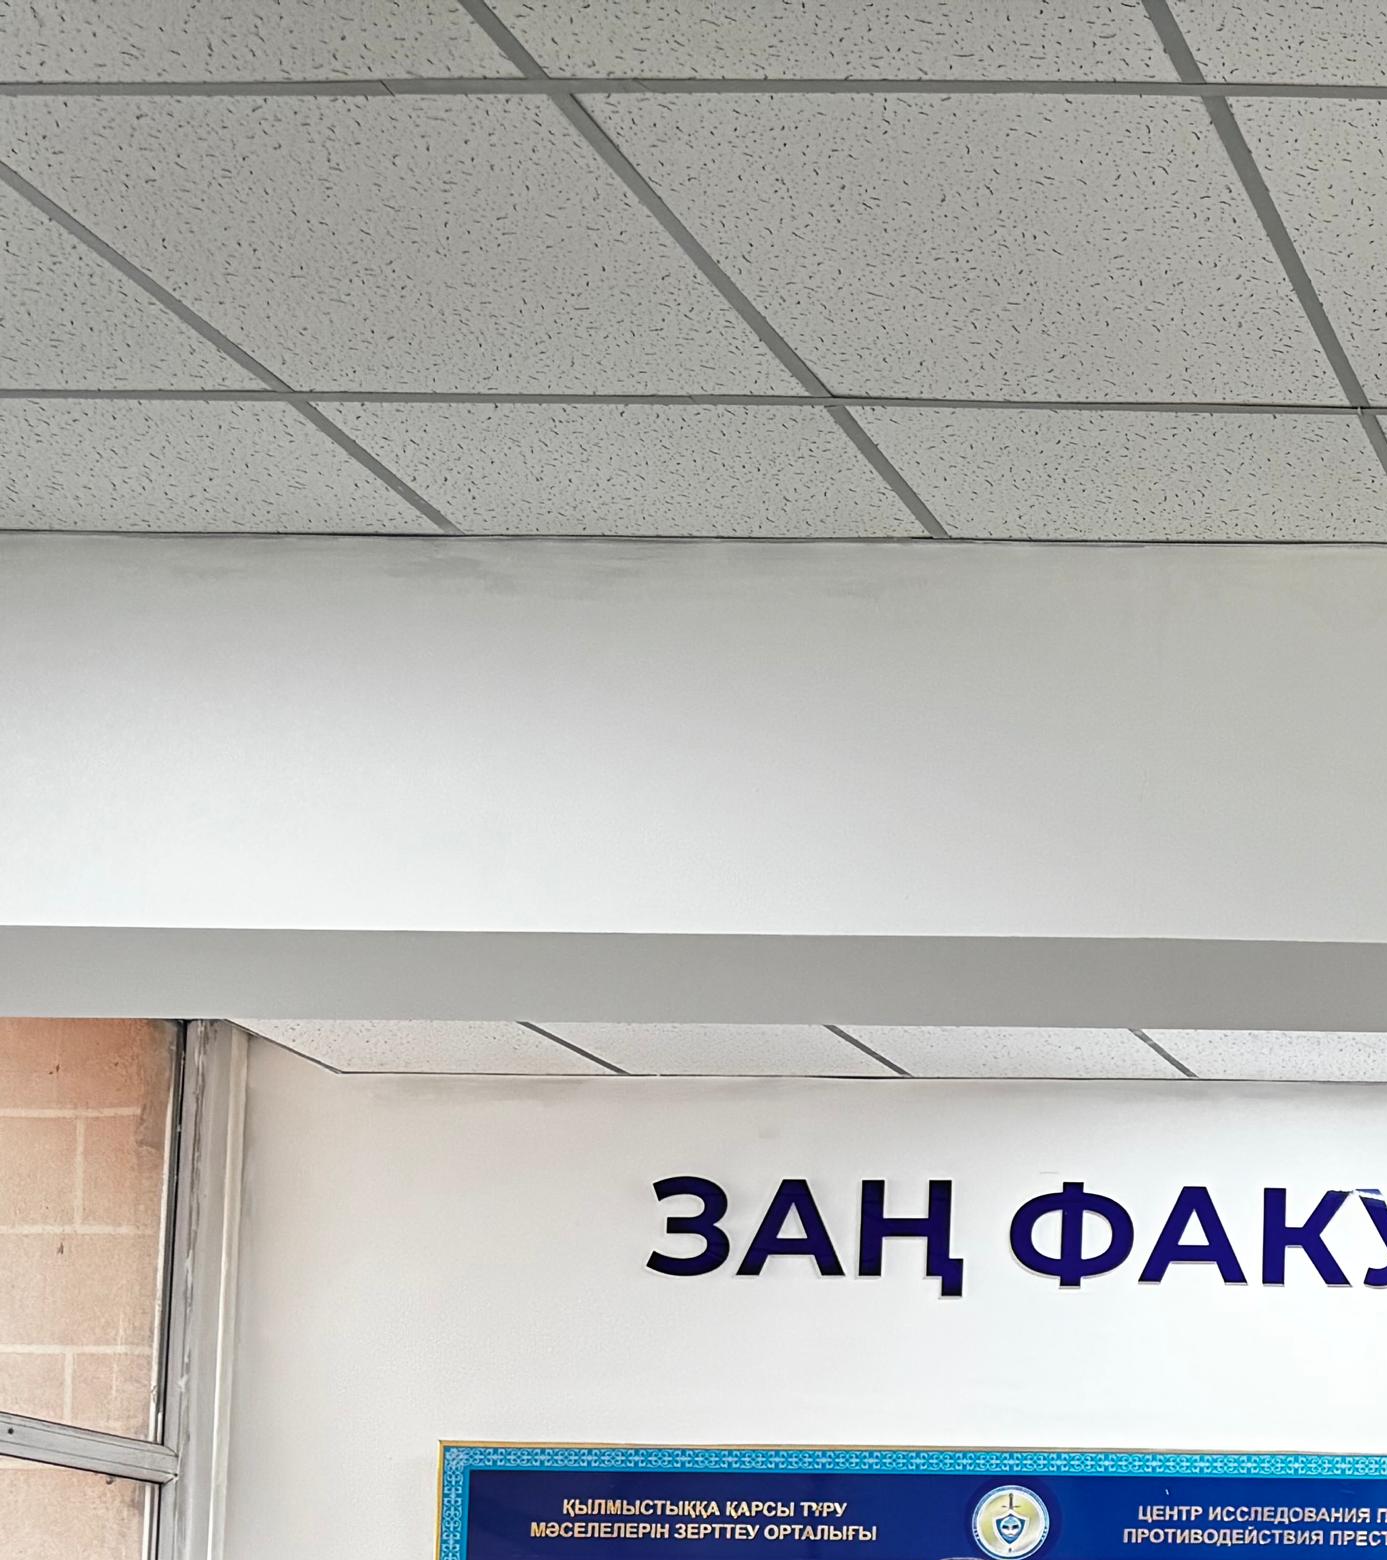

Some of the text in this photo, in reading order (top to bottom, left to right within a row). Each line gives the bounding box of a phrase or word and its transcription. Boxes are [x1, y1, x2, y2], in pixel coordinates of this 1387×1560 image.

[647, 1176, 963, 1297] ЗАҢ
[563, 1499, 720, 1518] ҚЫЛМЫСТЫҚҚА
[726, 1501, 794, 1519] ҚАРСЫ
[1139, 1506, 1202, 1523] ЦЕНТР
[1209, 1506, 1370, 1524] ИССЛЕДОВАНИЯ
[531, 1522, 876, 1540] МӘСЕЛЕЛЕРІН ЗЕРТТЕУ ОРТАЛЫҒЫ
[1124, 1526, 1323, 1546] ПРОТИВОДЕЙСТВИЯ
